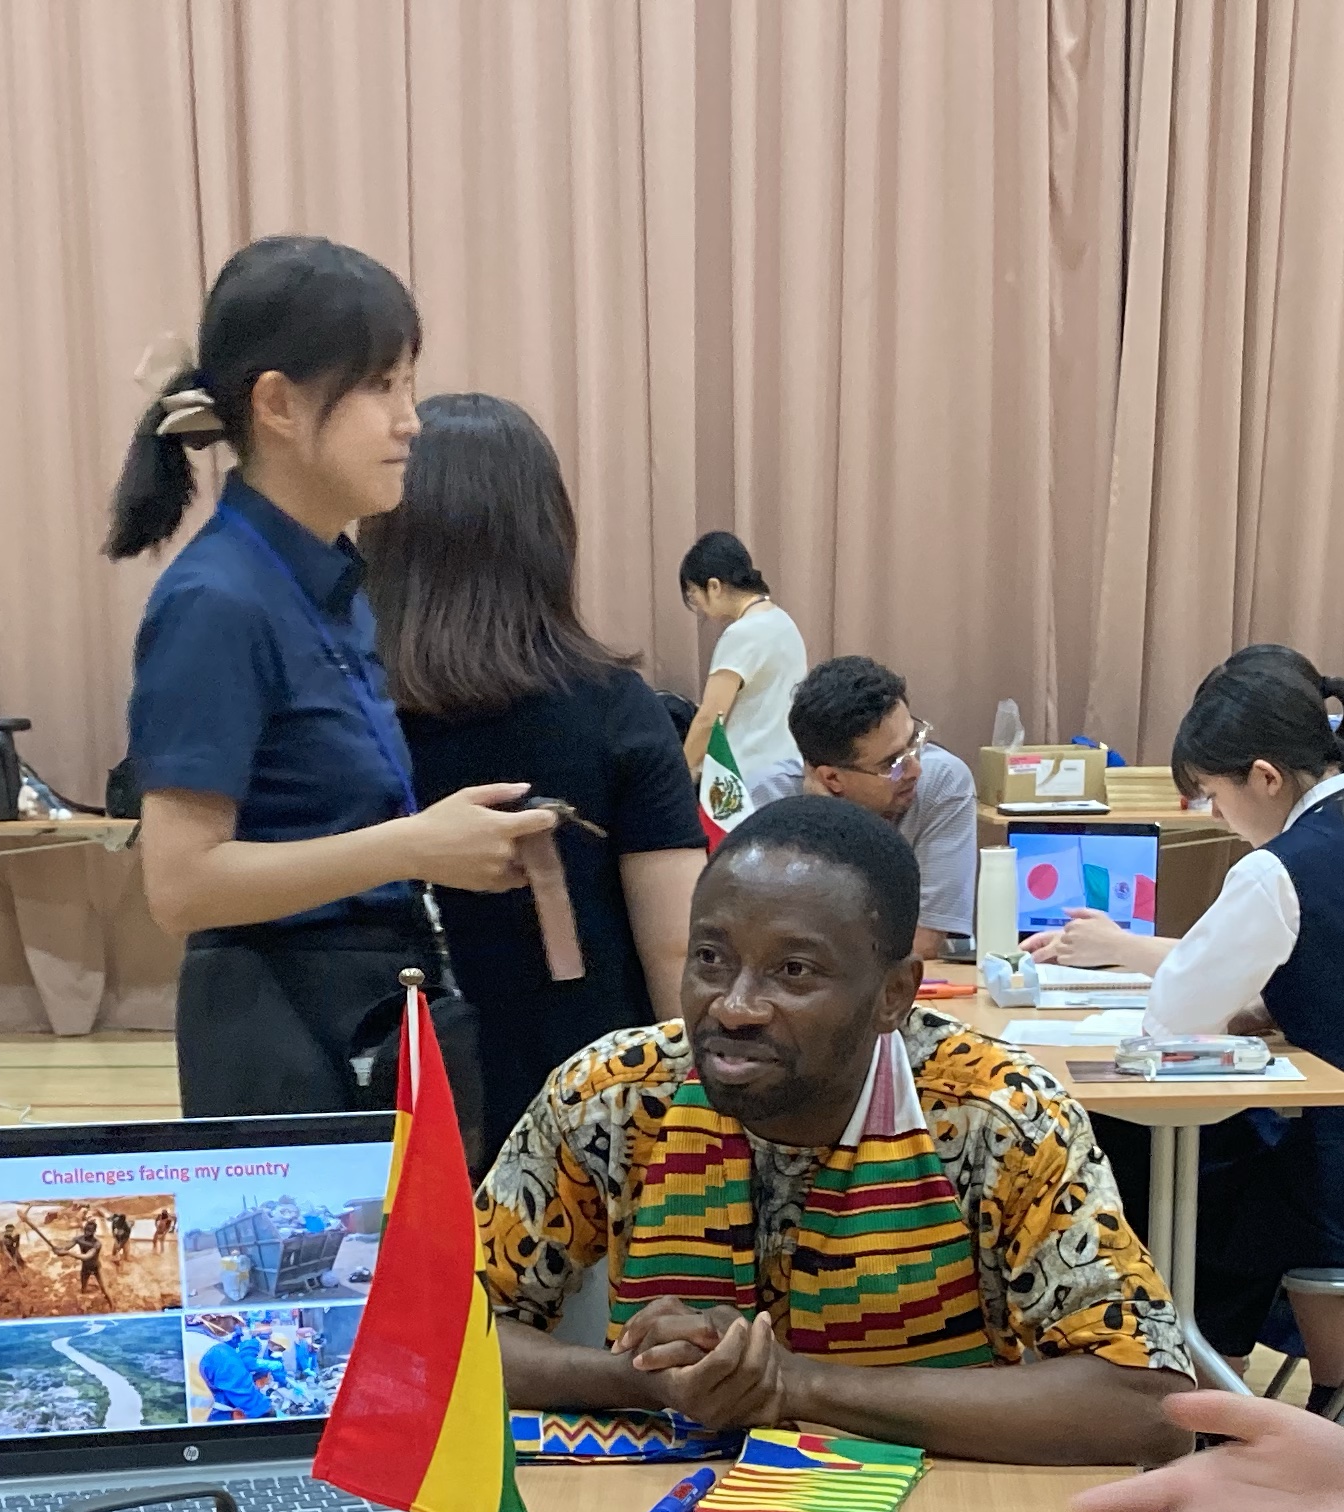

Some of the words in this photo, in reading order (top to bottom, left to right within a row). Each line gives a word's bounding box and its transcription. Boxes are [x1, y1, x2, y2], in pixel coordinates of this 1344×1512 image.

[41, 1168, 134, 1185] Challenges
[139, 1164, 190, 1182] facing
[195, 1165, 221, 1181] my
[225, 1161, 290, 1178] country
